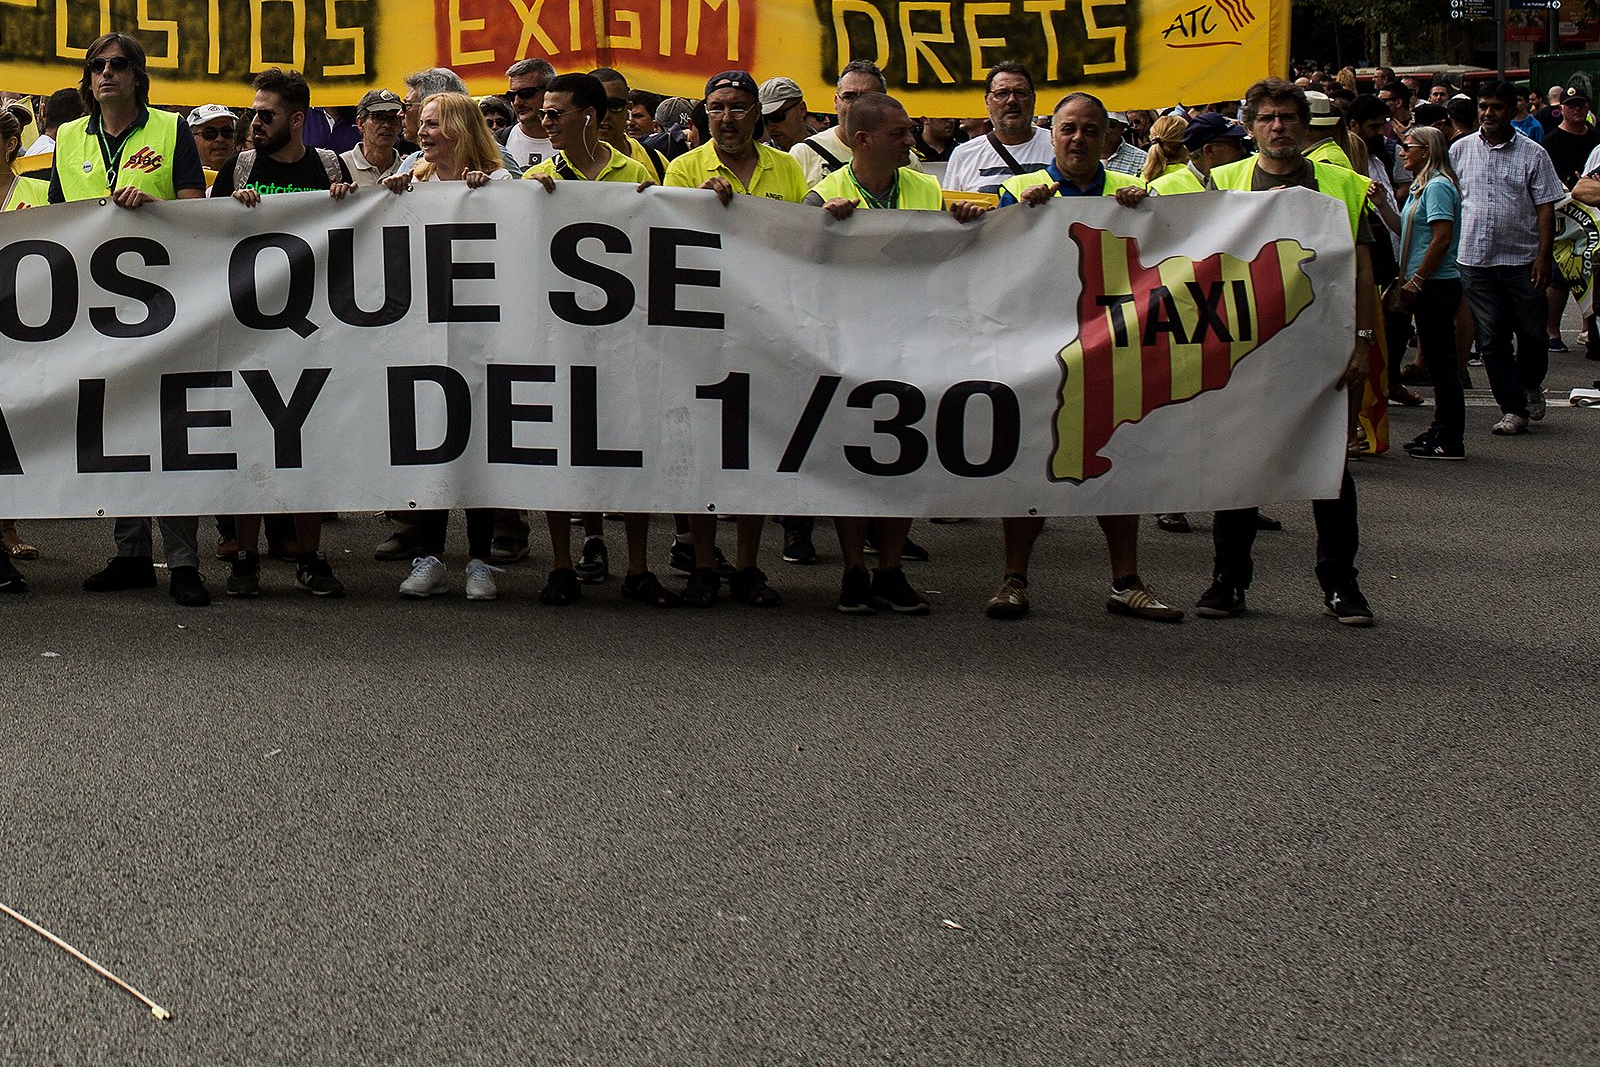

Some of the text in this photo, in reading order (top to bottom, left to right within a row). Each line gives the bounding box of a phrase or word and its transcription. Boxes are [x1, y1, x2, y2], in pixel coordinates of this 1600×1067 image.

[1162, 5, 1218, 39] ATC
[228, 222, 501, 339] QUE
[548, 222, 725, 329] SE
[1096, 280, 1252, 347] TAXI
[76, 368, 332, 474] LEY
[386, 364, 643, 468] DEL
[696, 371, 1021, 478] 1/30
